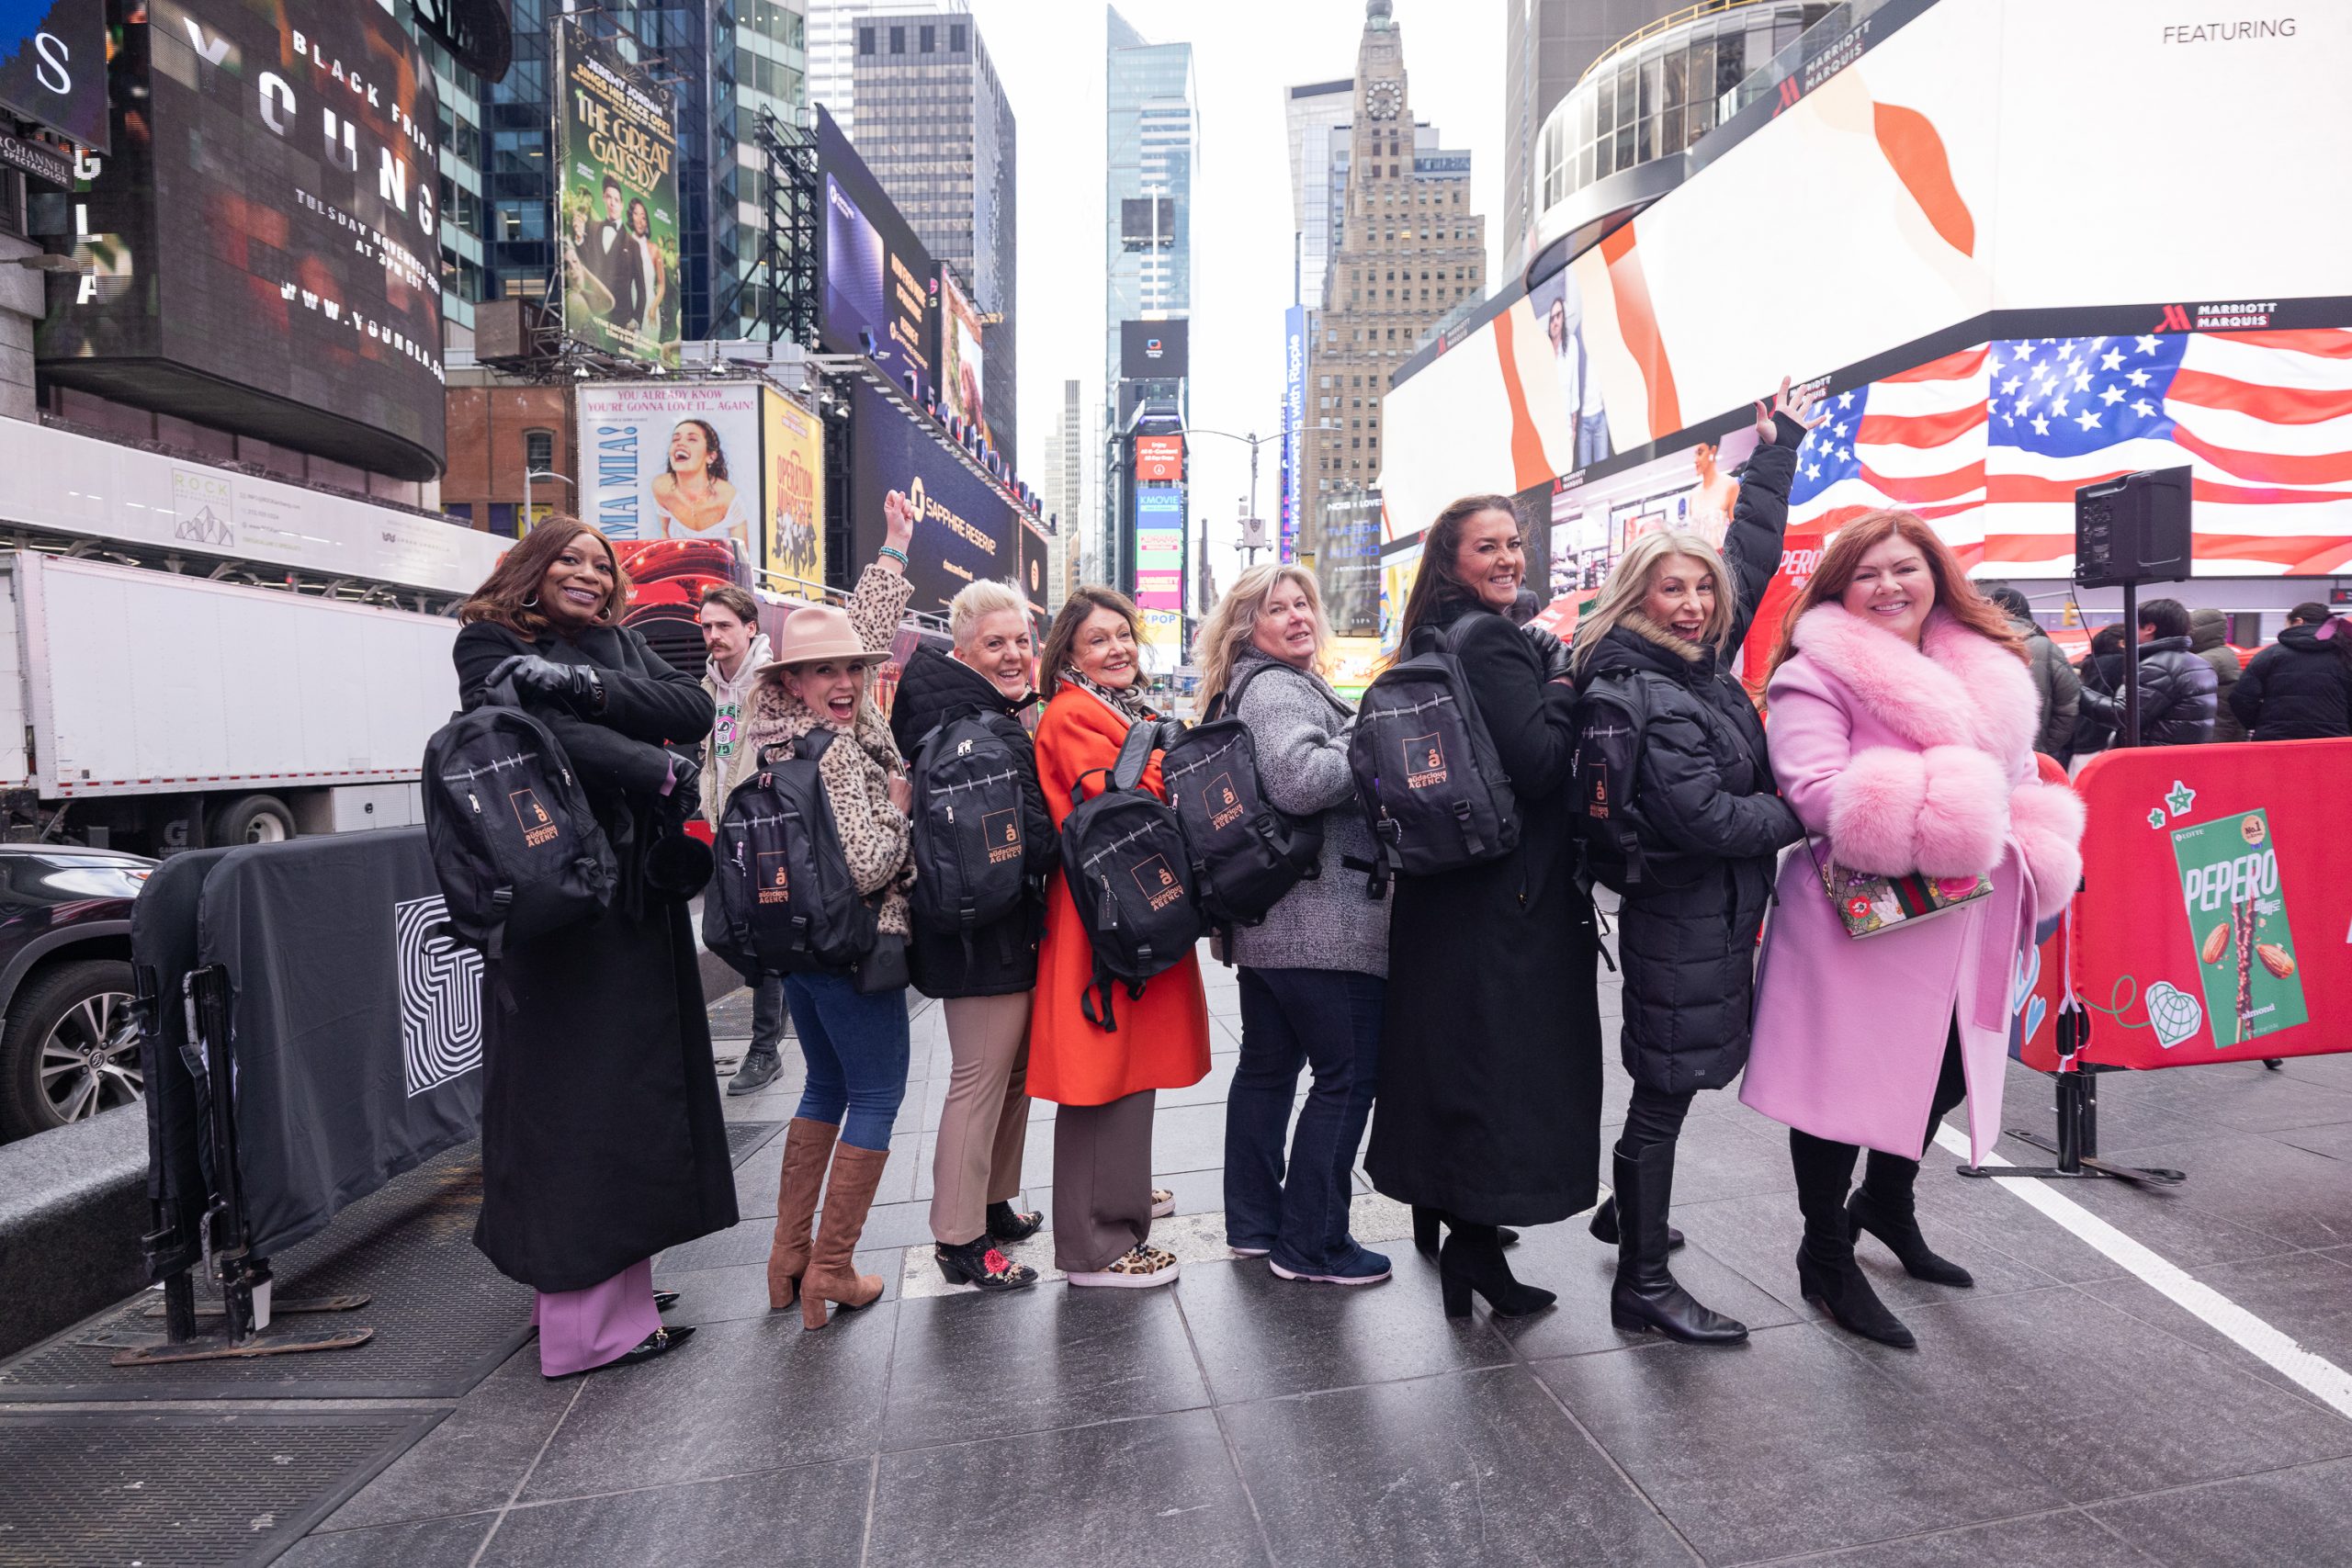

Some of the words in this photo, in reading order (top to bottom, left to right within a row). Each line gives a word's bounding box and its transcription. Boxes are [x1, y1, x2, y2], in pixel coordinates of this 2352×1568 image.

[2164, 18, 2295, 44] FEATURING
[1805, 19, 1871, 75] MARRIOTT
[293, 29, 379, 108] BLACK
[577, 63, 608, 91] SINGS
[1805, 42, 1862, 91] MARQUIS
[579, 94, 610, 137] THE
[613, 118, 671, 175] GREAT
[3, 150, 68, 185] SPECTACOLOR
[588, 131, 662, 191] GATSBY
[356, 240, 372, 257] AT
[2198, 302, 2278, 315] MARRIOTT
[2197, 316, 2267, 328] MARQUIS
[1288, 333, 1302, 383] Ripple
[587, 402, 624, 412] YOU'RE
[628, 401, 664, 412] GONNA
[667, 401, 694, 412] LOVE
[718, 400, 753, 411] AGAIN!
[617, 390, 638, 400] YOU
[642, 389, 688, 400] ALREADY
[692, 389, 723, 399] KNOW
[1289, 384, 1302, 418] with
[596, 426, 639, 488] MIA!
[175, 475, 228, 494] ROCK
[777, 455, 813, 499] OPERATION
[1140, 496, 1179, 504] KMOVIE
[926, 497, 966, 539] SAPPHIRE
[966, 523, 996, 557] RESERVE
[1329, 545, 1380, 558] HONO
[1774, 549, 1824, 577] PERO
[1408, 776, 1446, 789] AGENCY
[1216, 807, 1243, 830] AGENCY
[164, 820, 188, 846] G
[528, 828, 559, 847] AGENCY
[2183, 829, 2204, 840] LOTTE
[990, 850, 1022, 864] AGENCY
[2185, 849, 2278, 916] PEPERO
[759, 896, 788, 904] AGENCY
[1153, 889, 1183, 911] AGENCY
[2242, 1003, 2276, 1020] almond
